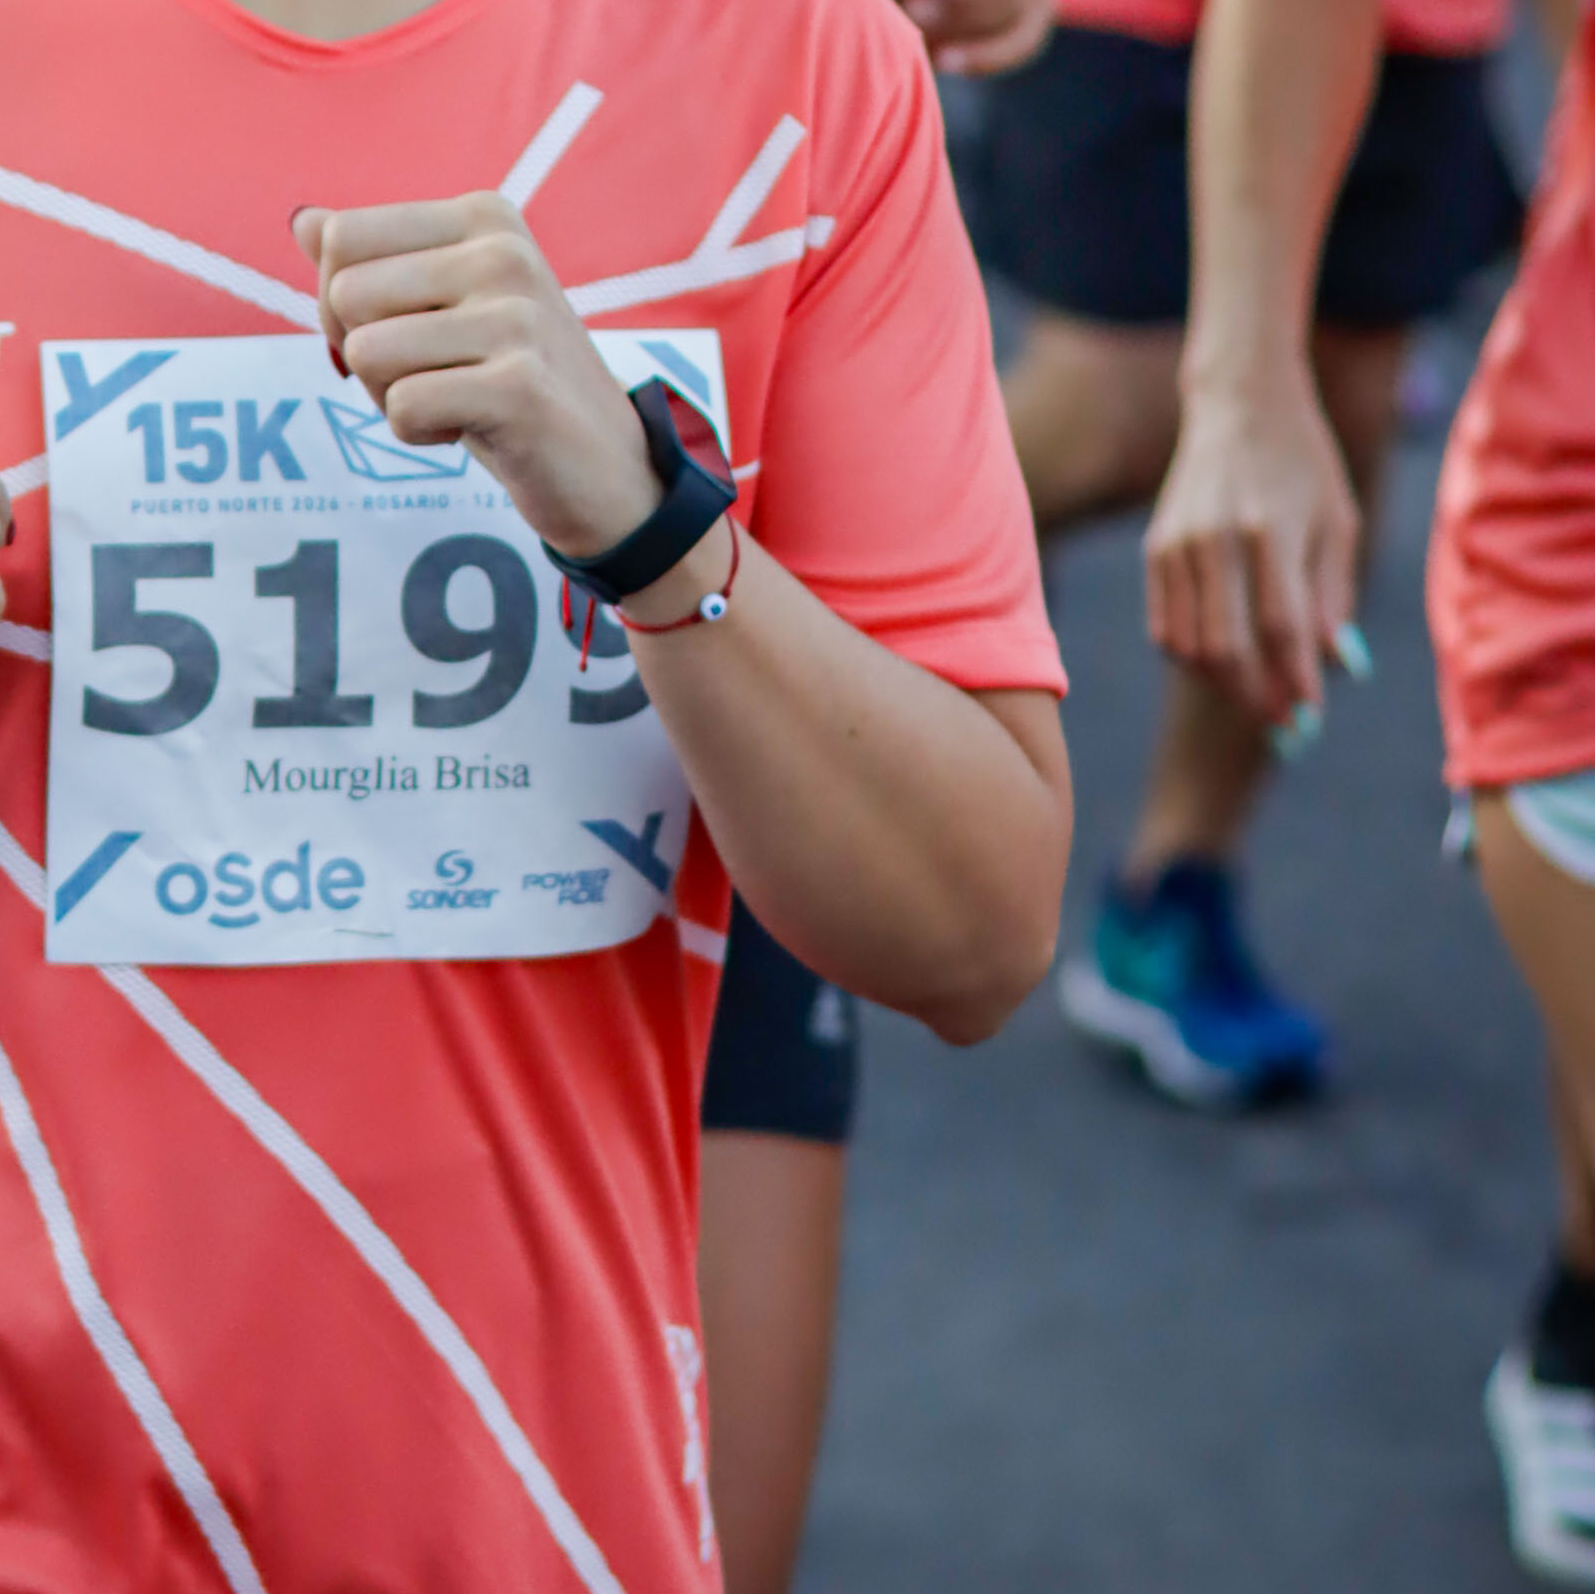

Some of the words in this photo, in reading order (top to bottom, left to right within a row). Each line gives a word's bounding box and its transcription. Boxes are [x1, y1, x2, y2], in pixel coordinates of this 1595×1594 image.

[126, 399, 306, 484] 15K
[131, 497, 210, 514] PUERTO
[219, 496, 284, 513] NORTE
[362, 493, 450, 510] ROSARIO
[243, 757, 419, 800] Mourglia
[434, 755, 532, 791] Brisa
[155, 841, 365, 915] osde
